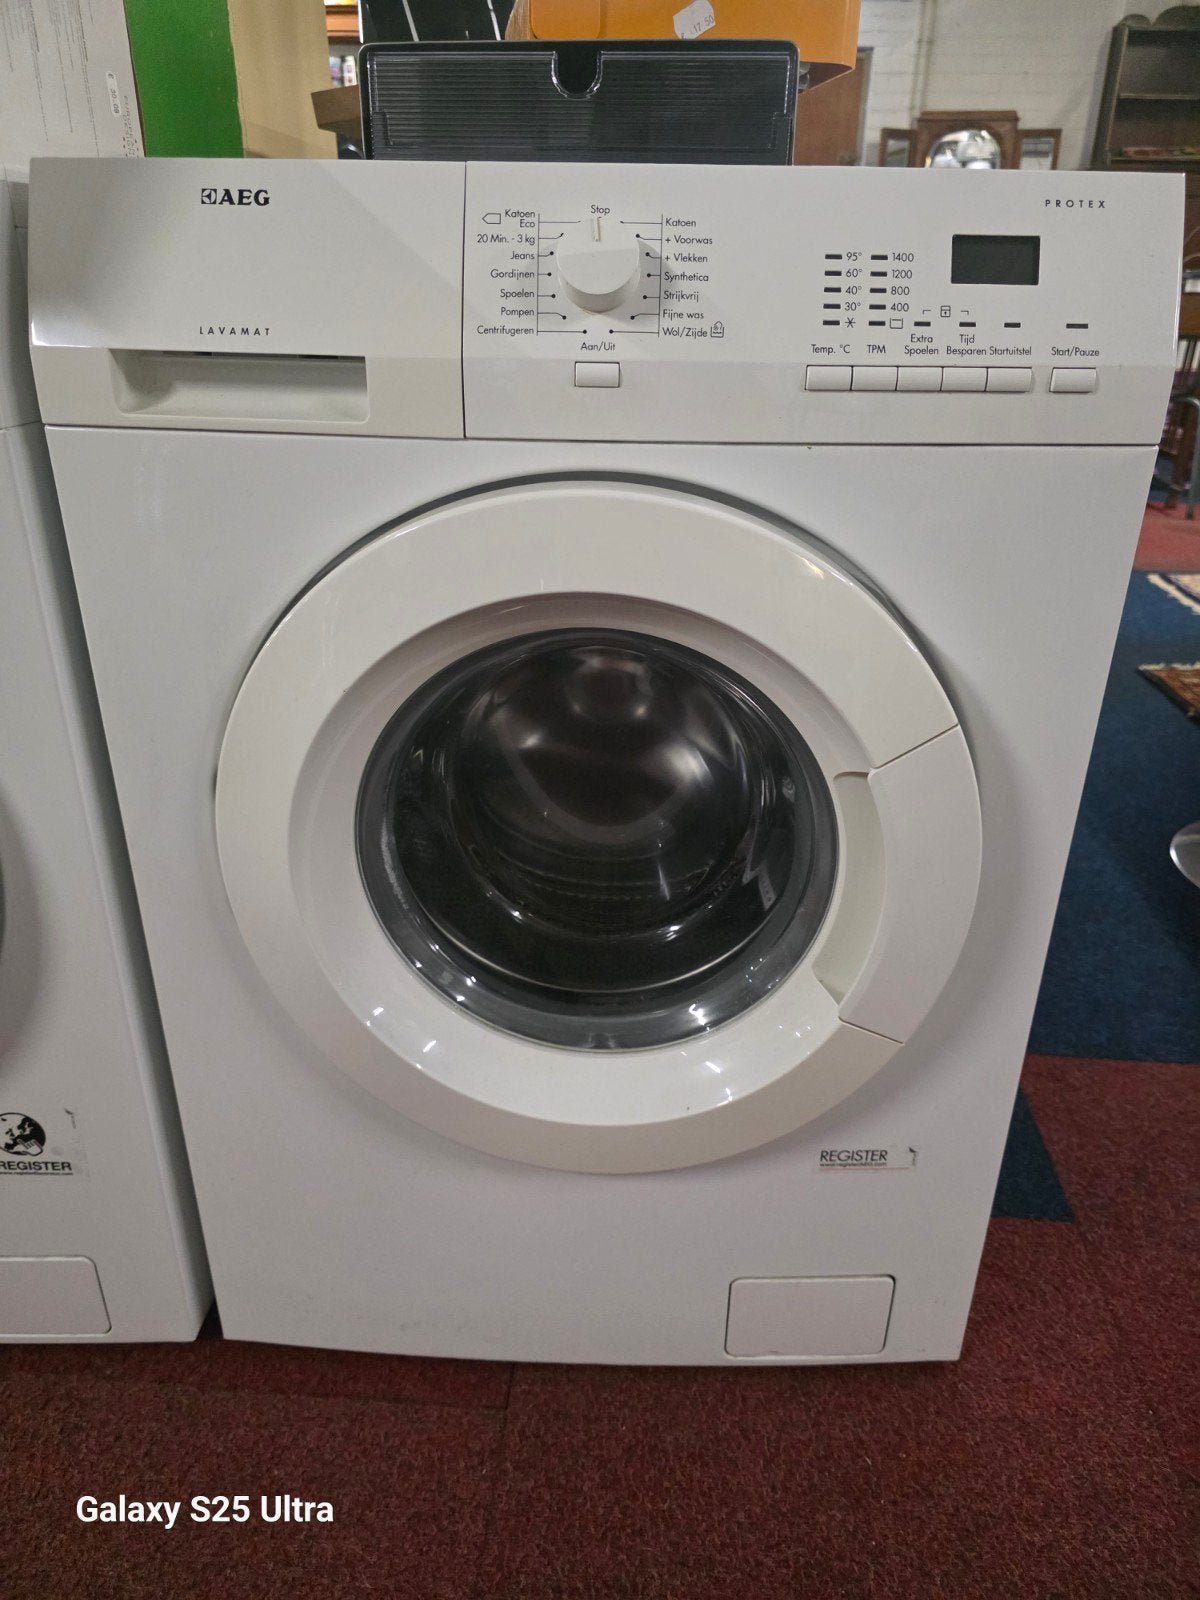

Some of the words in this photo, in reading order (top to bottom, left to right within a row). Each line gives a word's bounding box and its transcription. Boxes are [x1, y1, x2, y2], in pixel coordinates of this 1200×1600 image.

[218, 189, 270, 206] AEG
[1045, 199, 1105, 208] PROTEX
[505, 209, 535, 218] Katoen
[591, 205, 610, 215] Stop
[520, 219, 535, 228] Eco
[666, 218, 696, 226] Katoen
[477, 234, 488, 243] 20
[490, 234, 510, 242] Min.
[517, 234, 522, 243] 3
[525, 234, 535, 245] kg
[674, 235, 712, 244] Voorwas
[510, 251, 535, 259] Jeans
[674, 253, 707, 262] Vlekken
[846, 252, 862, 261] 95°
[893, 253, 914, 262] 1400
[490, 269, 535, 280] Gordijnen
[664, 272, 708, 284] Synthetica
[846, 268, 862, 277] 60°
[892, 269, 912, 279] 1200
[500, 289, 534, 300] Spoelen
[846, 286, 862, 295] 40°
[891, 286, 910, 295] 800
[663, 291, 698, 303] Strijkvrij
[501, 307, 534, 317] Pompen
[845, 302, 861, 311] 30°
[891, 303, 909, 312] 400
[663, 310, 683, 321] Fijne
[200, 327, 269, 335] LAVAMAT
[477, 325, 534, 336] Centrifugeren
[663, 327, 707, 338] Wol/Zijde
[911, 334, 933, 343] Extra
[960, 334, 975, 345] Tijd
[581, 342, 615, 351] Aan/Uit
[811, 344, 835, 355] Temp.
[867, 345, 886, 353] TPM
[905, 345, 938, 357] Spoelen
[947, 346, 986, 357] Besparen
[990, 346, 1031, 355] Startuitstel
[1051, 347, 1099, 356] Start/Pauze
[820, 1149, 888, 1162] REGISTER
[0, 1160, 73, 1171] REGISTER
